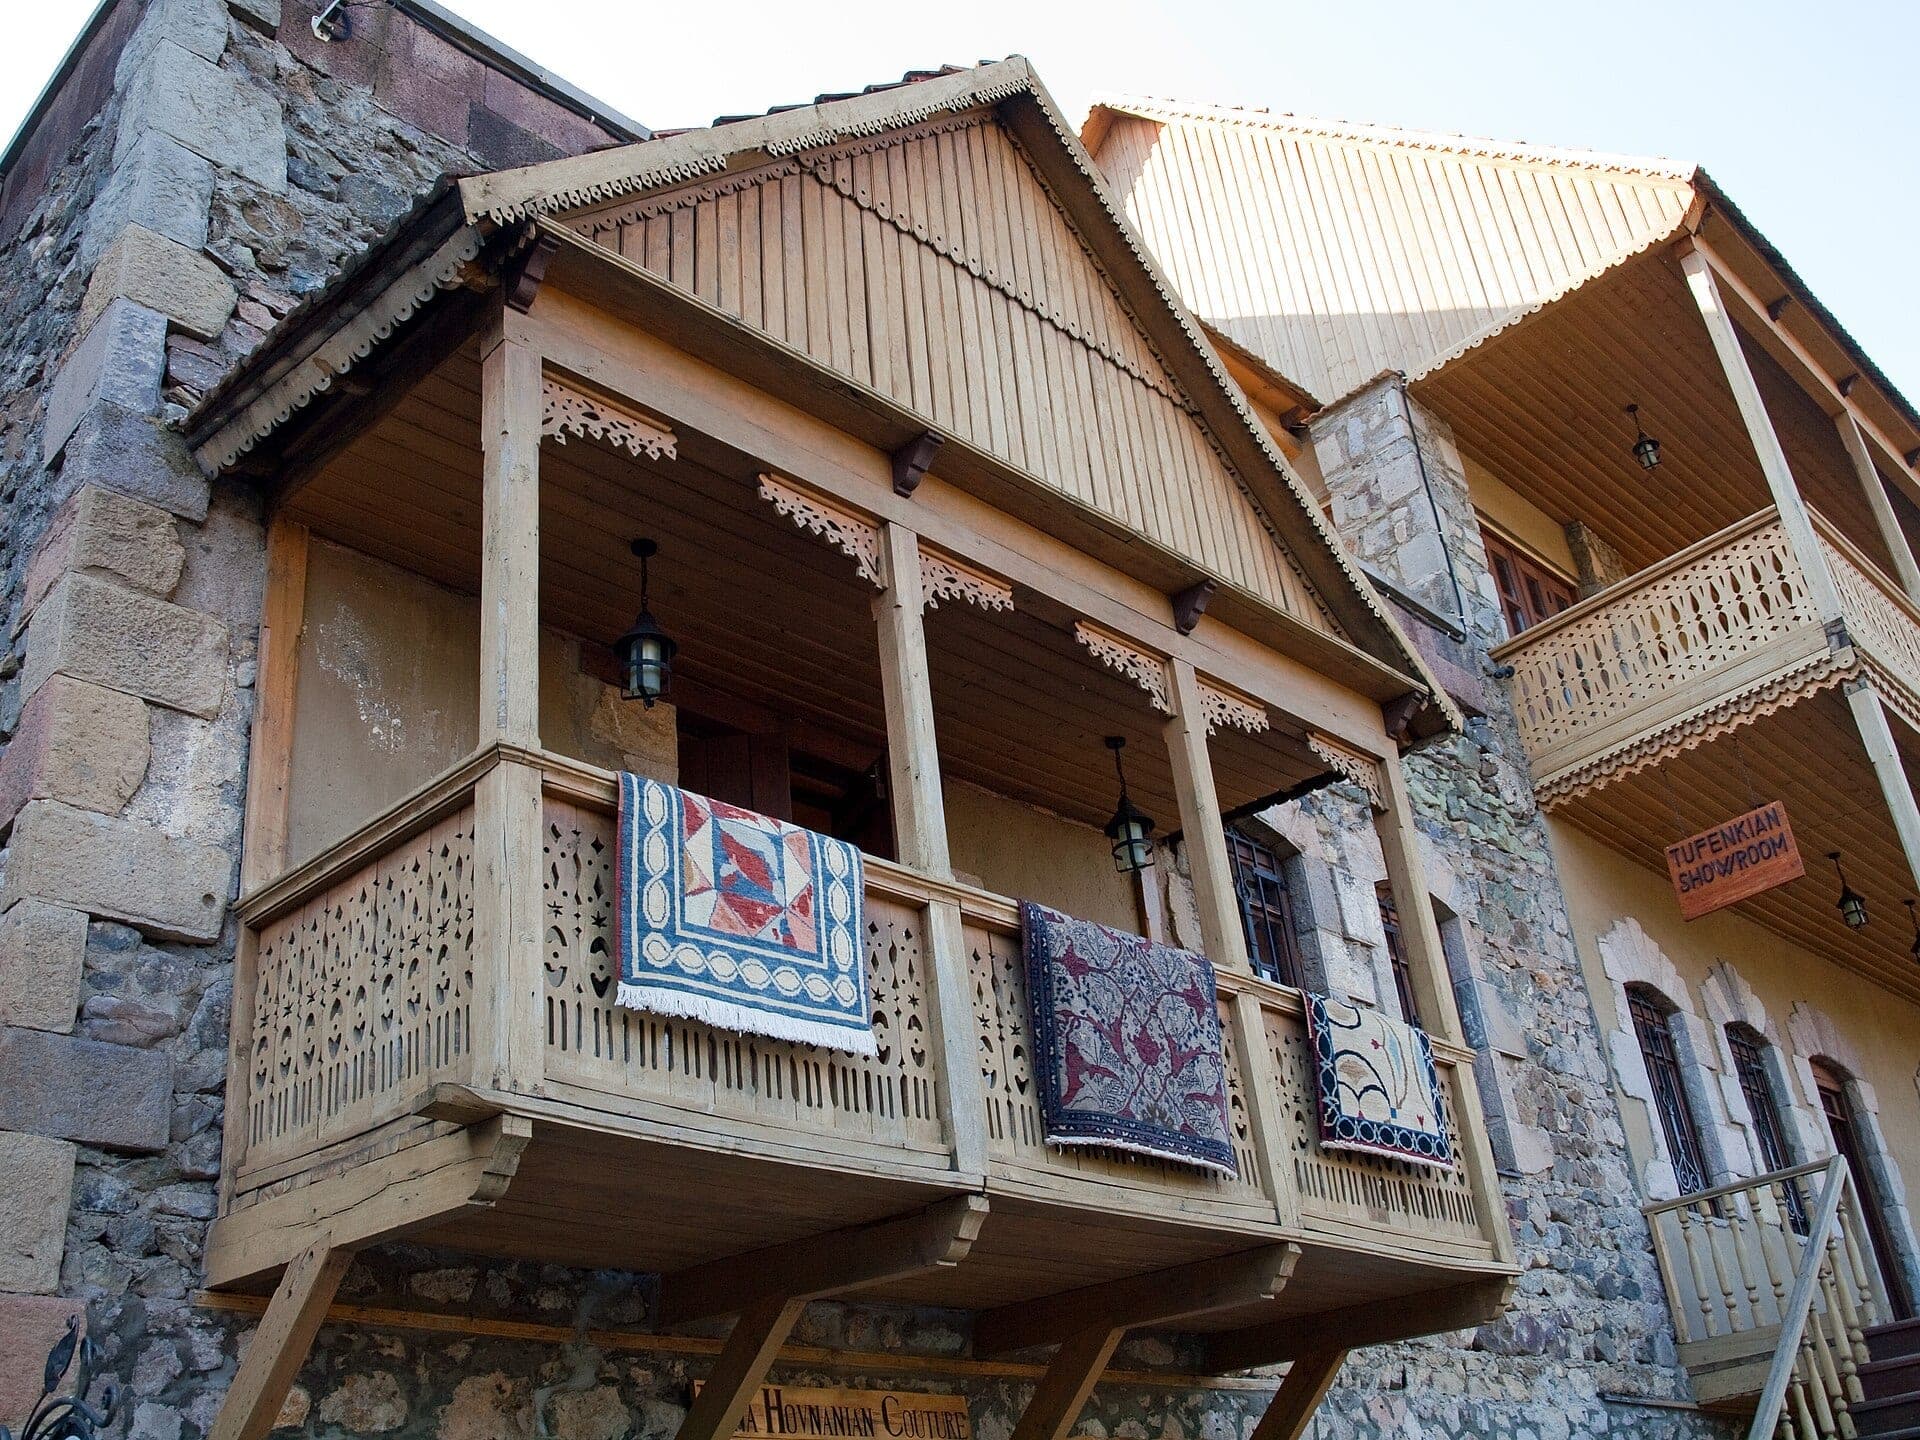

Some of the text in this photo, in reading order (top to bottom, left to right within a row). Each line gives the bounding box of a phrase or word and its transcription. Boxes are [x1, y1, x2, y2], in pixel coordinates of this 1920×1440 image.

[1668, 806, 1781, 867] TUFENKIAN
[1679, 832, 1788, 892] SHOWROOM
[762, 1388, 875, 1437] HOVNANIAN
[881, 1395, 969, 1440] COUTURE
